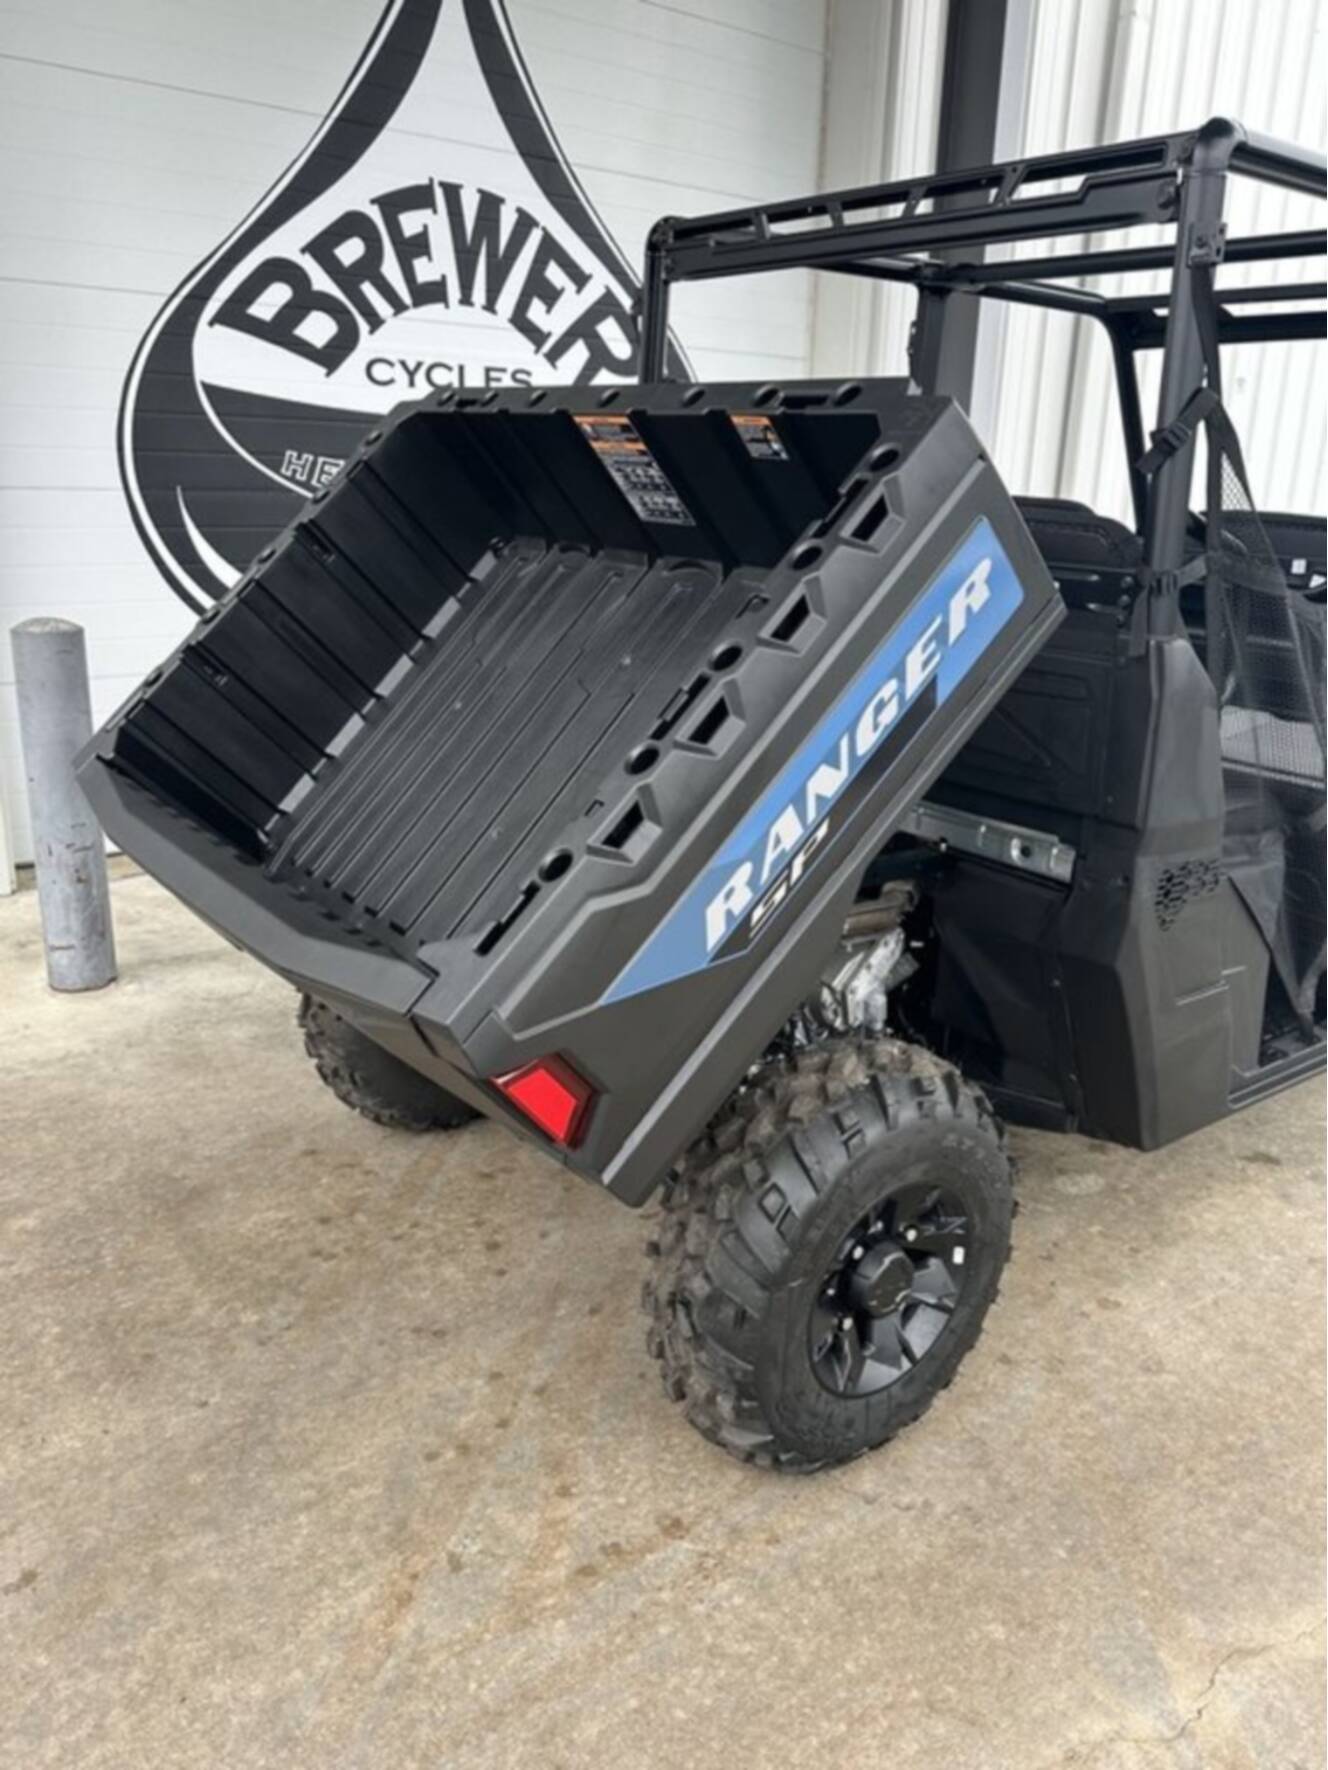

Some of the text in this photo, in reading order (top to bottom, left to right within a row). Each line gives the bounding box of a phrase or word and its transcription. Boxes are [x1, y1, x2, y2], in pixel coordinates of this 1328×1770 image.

[207, 177, 641, 385] BREWER
[365, 358, 533, 388] CYCLES
[705, 557, 992, 952] RANGER
[748, 817, 830, 939] SP
